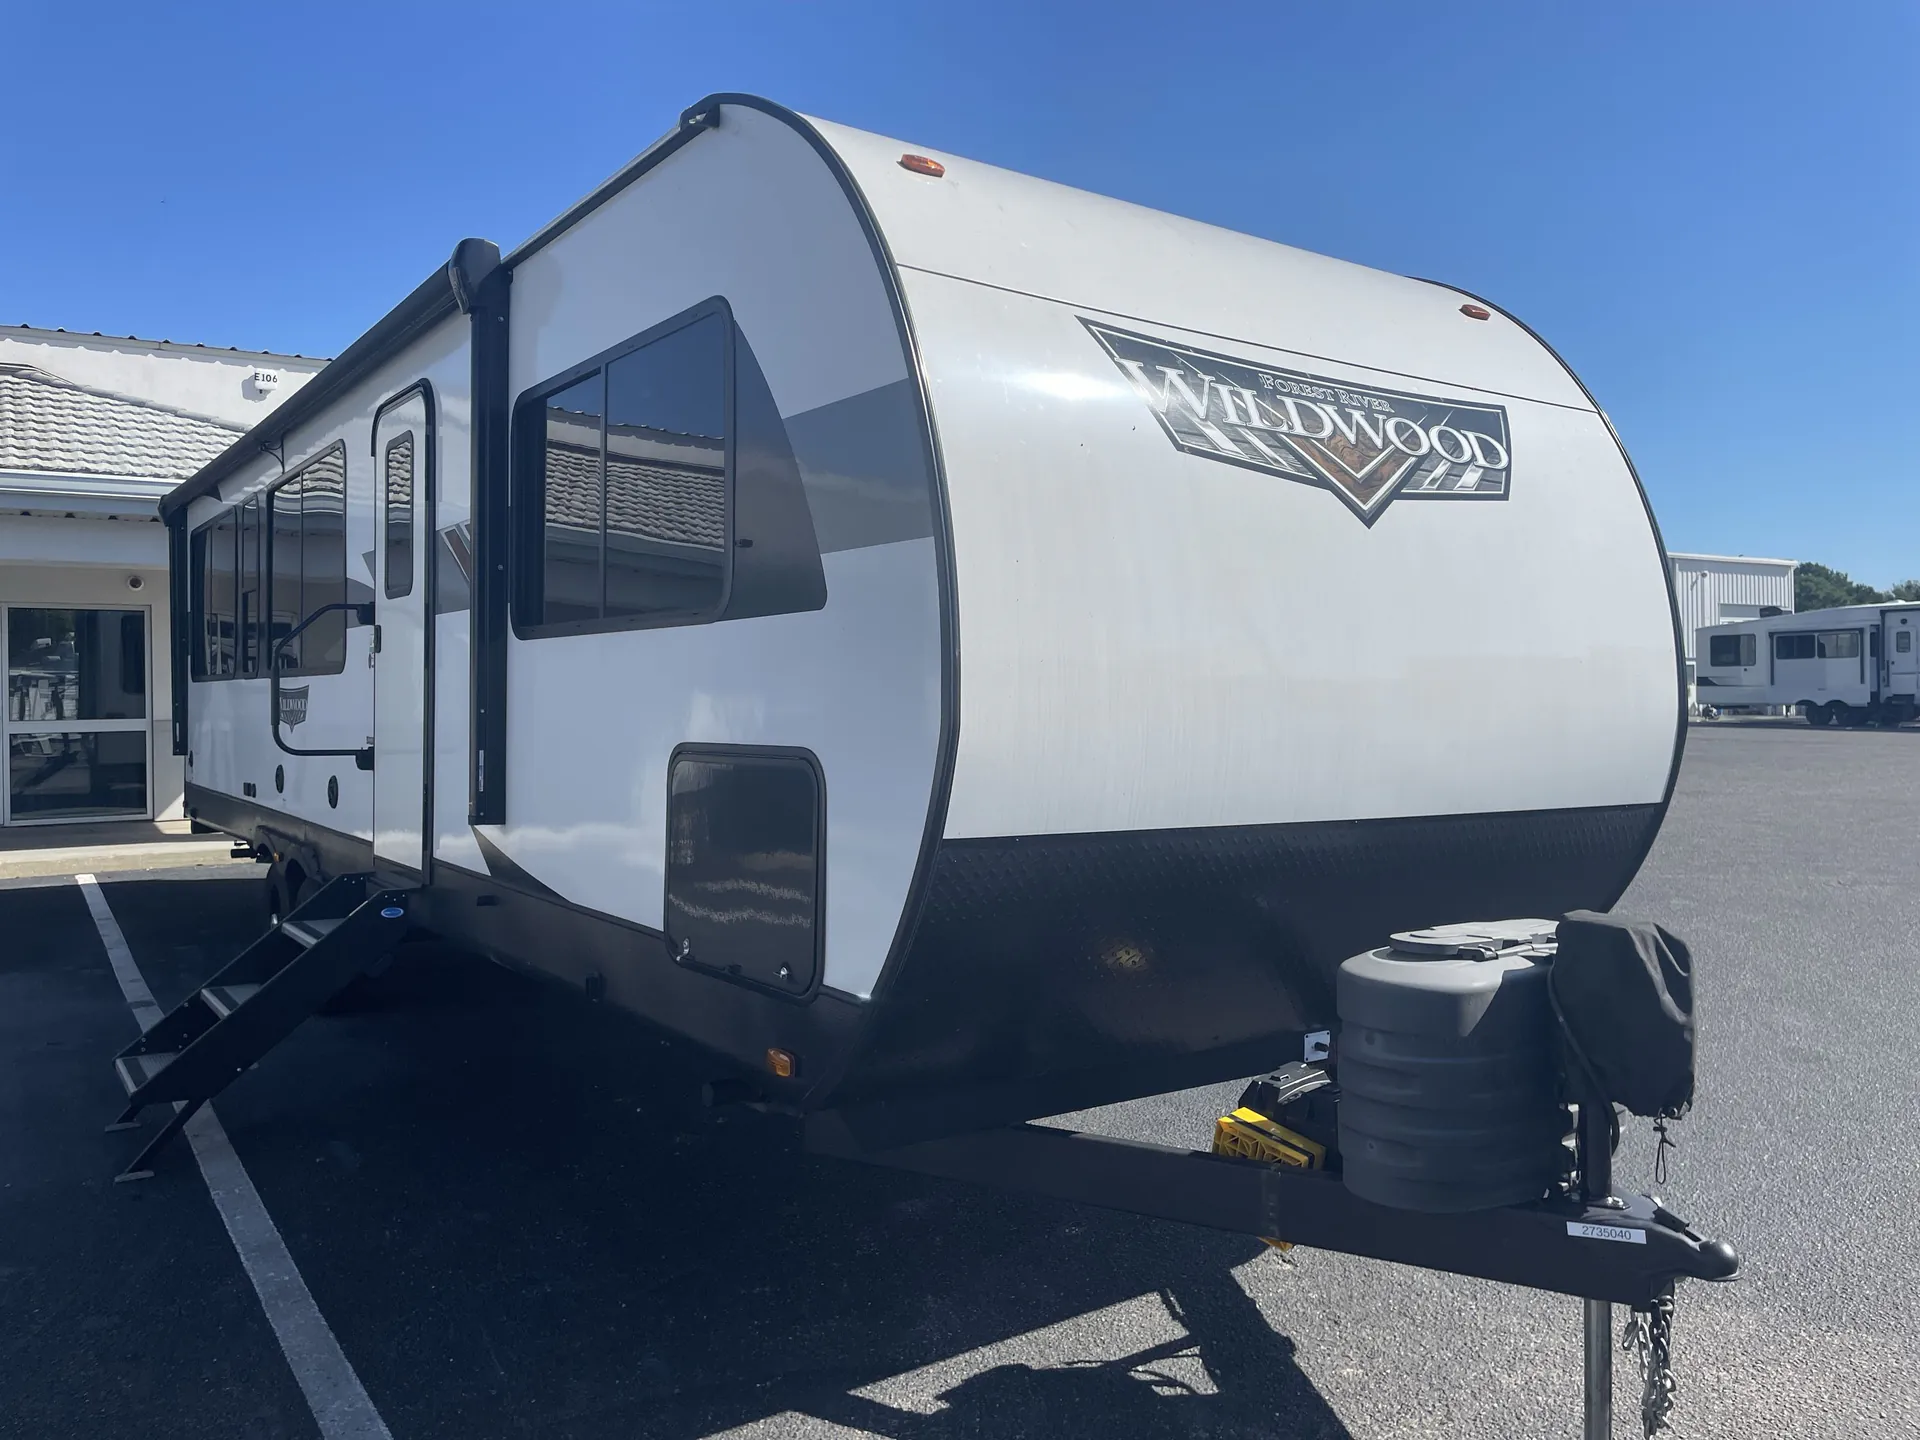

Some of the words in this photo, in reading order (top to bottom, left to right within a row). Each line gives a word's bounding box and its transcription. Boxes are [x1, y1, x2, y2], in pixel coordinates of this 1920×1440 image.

[1113, 357, 1509, 469] WILDWOOD
[1259, 373, 1335, 401] FOREST
[1334, 388, 1395, 413] RIVER
[1582, 1225, 1632, 1241] 2735040
